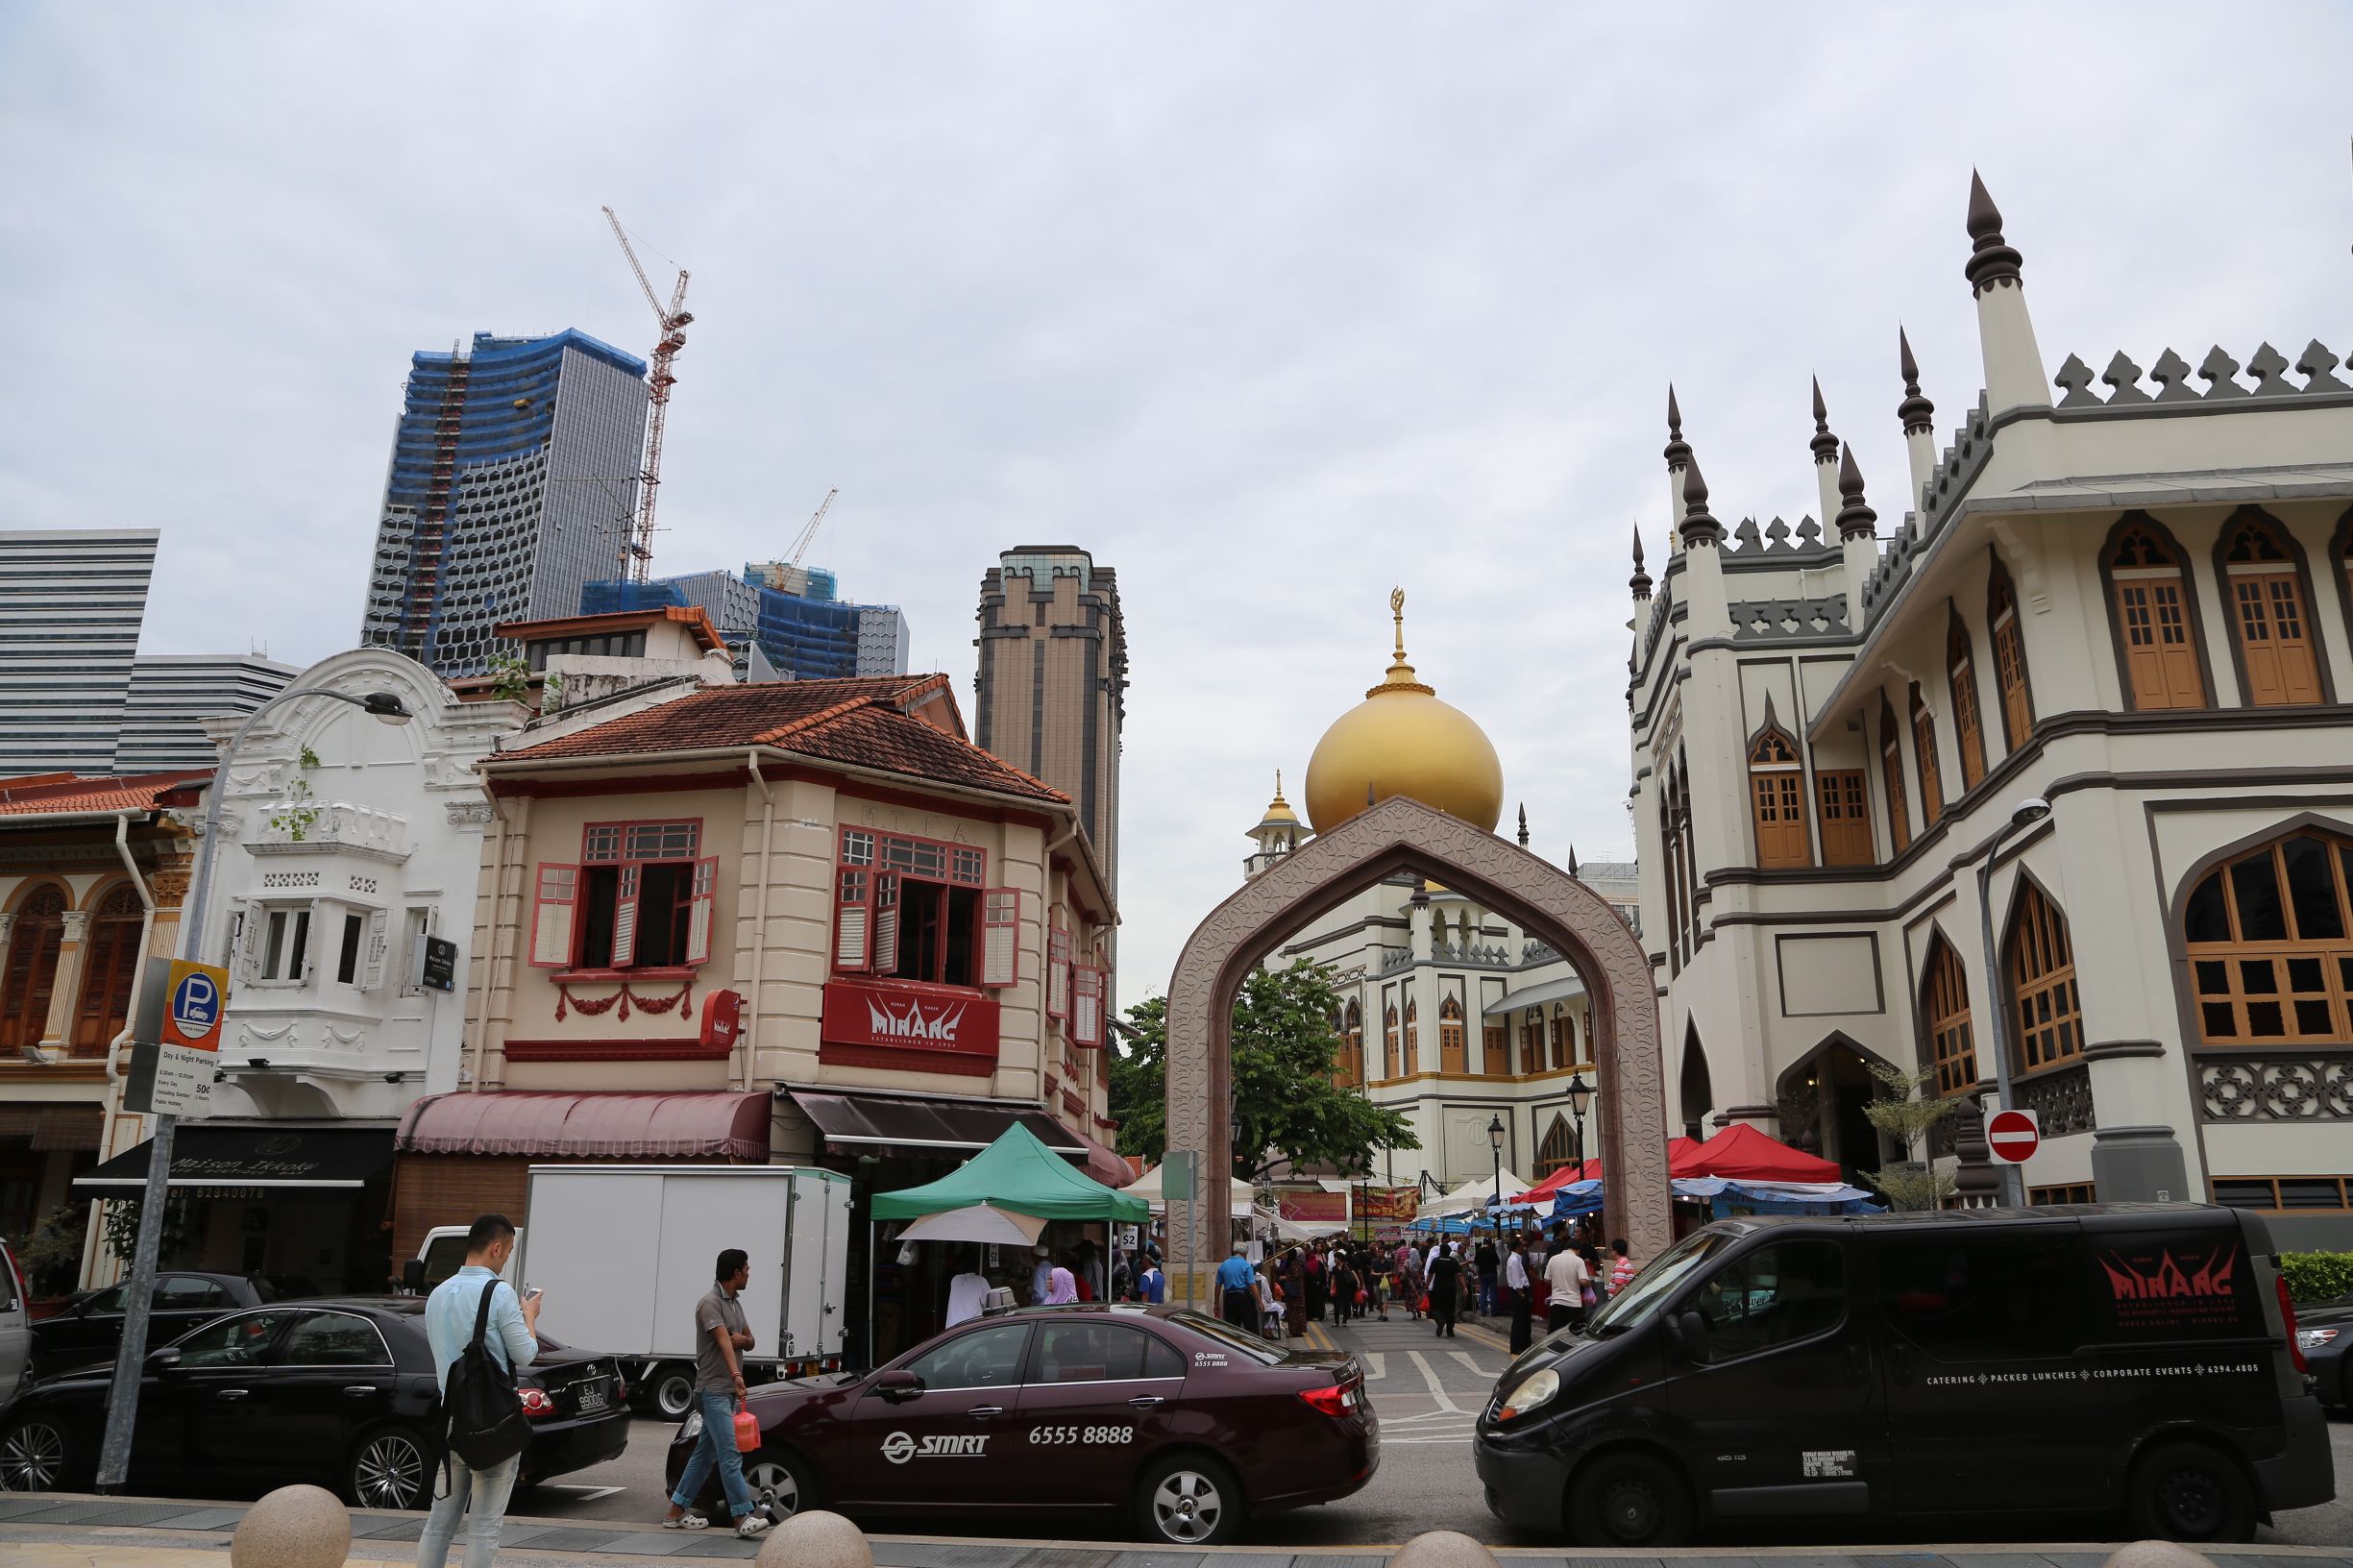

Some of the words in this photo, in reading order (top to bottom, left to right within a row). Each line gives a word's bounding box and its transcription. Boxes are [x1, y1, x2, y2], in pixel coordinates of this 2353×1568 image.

[184, 977, 212, 1018] P
[866, 992, 968, 1041] MINANG
[163, 1052, 173, 1060] Day
[181, 1055, 194, 1063] Night
[196, 1057, 214, 1067] Parking
[170, 1158, 242, 1168] Maison
[1123, 1234, 1135, 1245] $2
[2097, 1243, 2237, 1299] MINANG
[1927, 1375, 1975, 1385] CATERING
[1991, 1373, 2028, 1382] PACKED
[2033, 1371, 2076, 1381] LUNCHES
[2094, 1368, 2151, 1378] CORPORATE
[2155, 1367, 2192, 1375] EVENTS
[2208, 1364, 2258, 1373] 6294.4805
[584, 1384, 594, 1396] EJ
[1029, 1426, 1078, 1444] 6555
[1082, 1426, 1133, 1444] 8888
[917, 1435, 990, 1454] SMRT
